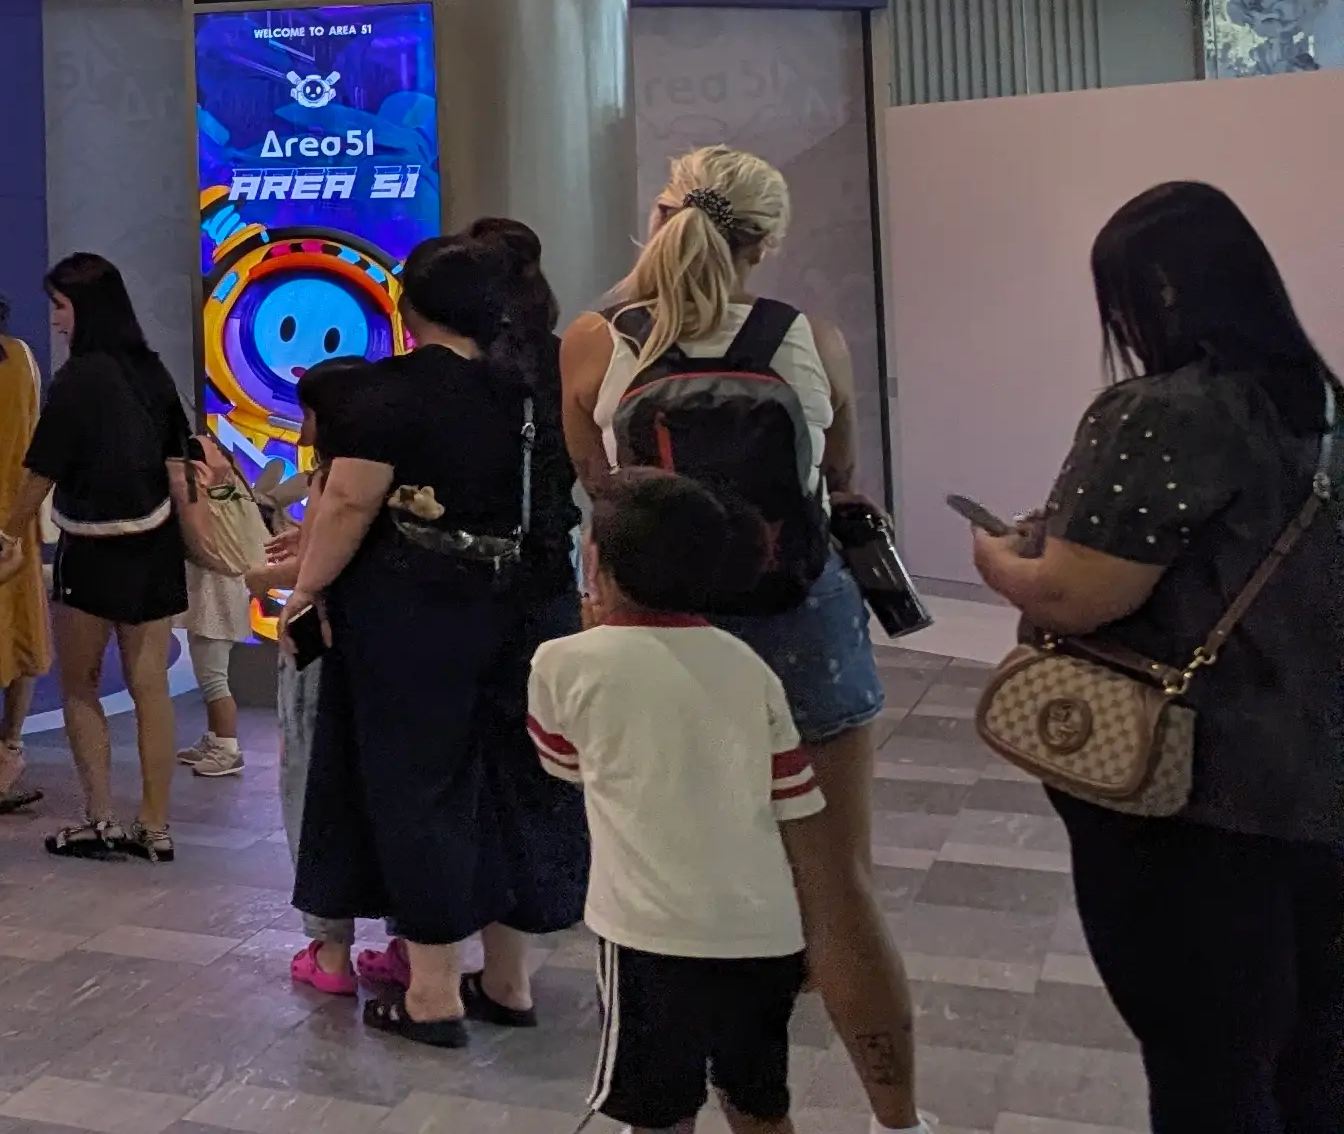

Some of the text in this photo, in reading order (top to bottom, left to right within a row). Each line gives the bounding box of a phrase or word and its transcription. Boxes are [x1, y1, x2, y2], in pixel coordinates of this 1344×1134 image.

[253, 23, 373, 40] WELCOME TO AREA 51
[260, 128, 374, 158] Area 51
[228, 164, 421, 201] AREA 51
